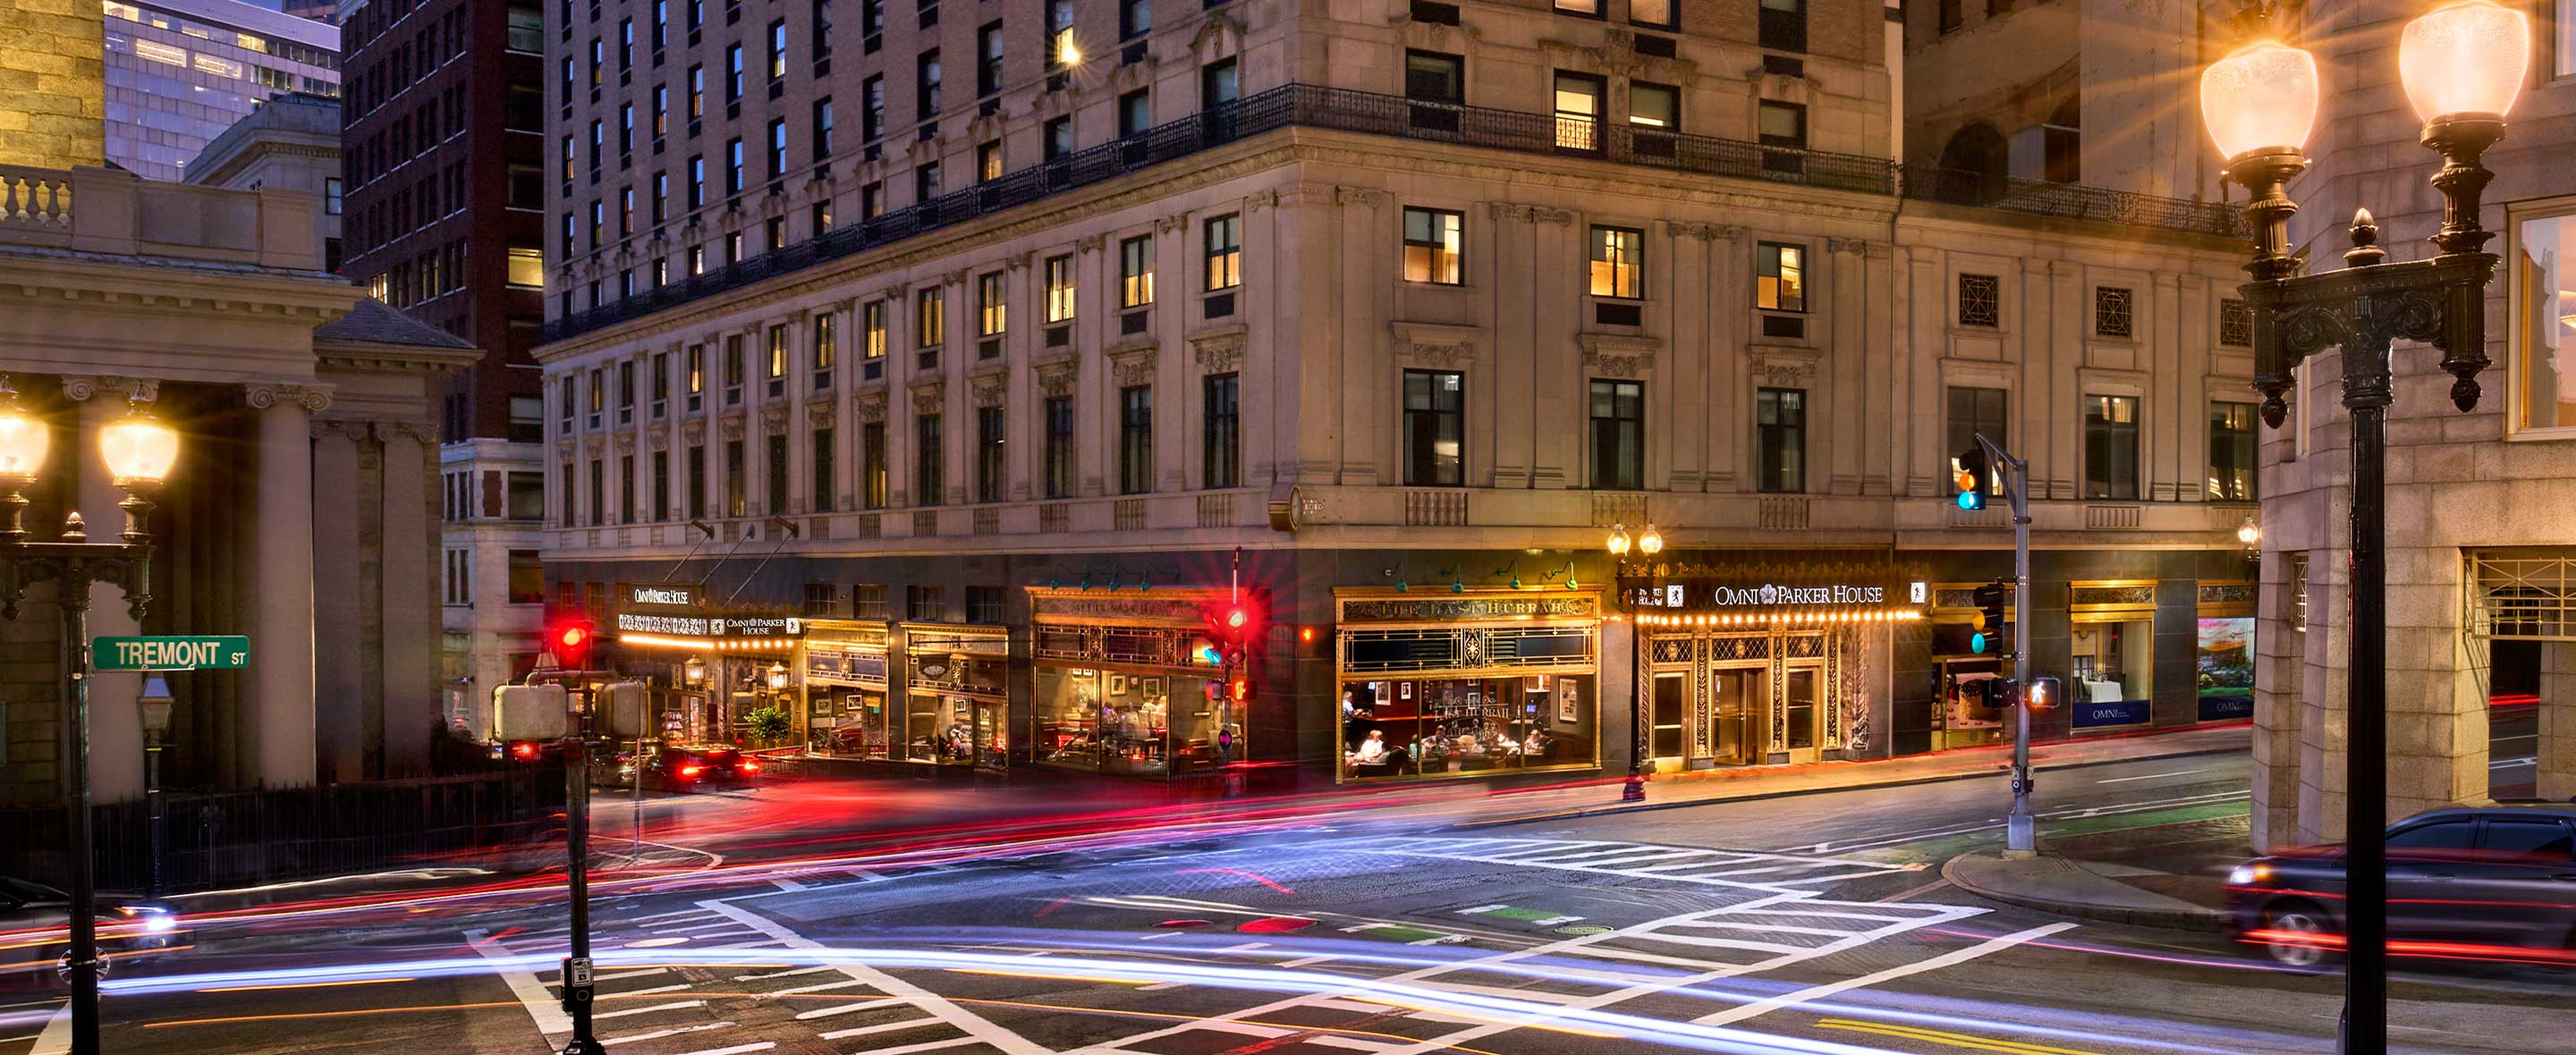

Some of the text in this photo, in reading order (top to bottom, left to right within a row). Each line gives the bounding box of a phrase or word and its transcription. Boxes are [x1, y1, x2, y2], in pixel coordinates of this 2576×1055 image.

[635, 588, 688, 604] OMNI PARKER HOUSE
[1716, 585, 1883, 605] OMNI PARKER HOUSE
[1430, 603, 1477, 615] LAST
[1487, 603, 1561, 614] HURRAH
[726, 618, 785, 628] OMNI PARKER
[743, 627, 769, 635] HOUSE
[115, 641, 246, 665] TREMONT ST
[2216, 701, 2240, 712] OMNI
[1465, 706, 1510, 720] HURRAH
[2092, 709, 2118, 720] OMNI
